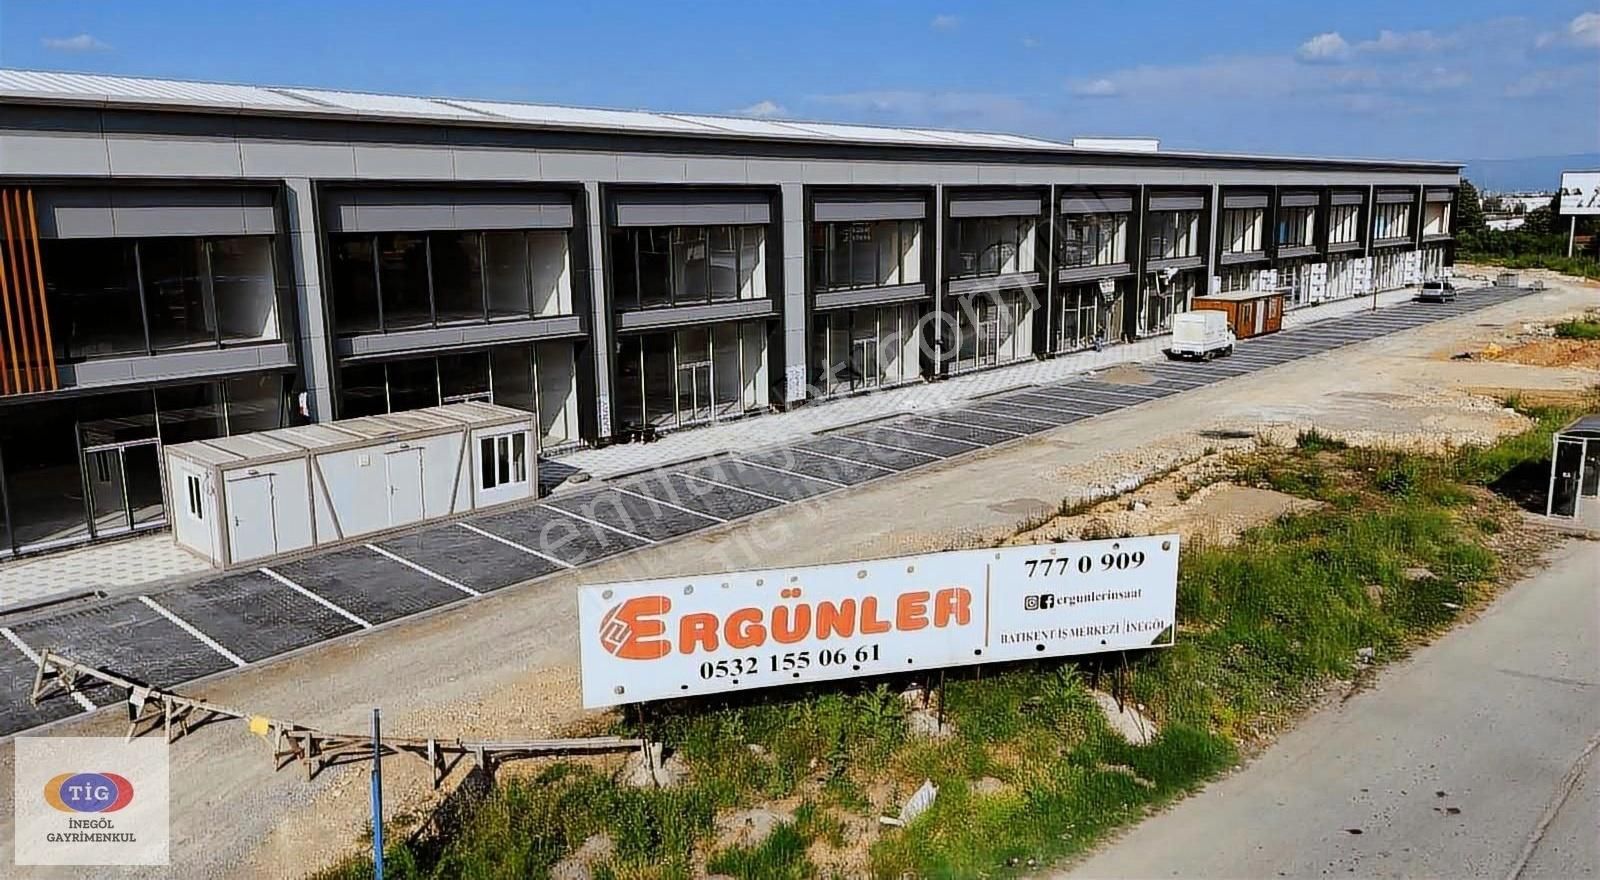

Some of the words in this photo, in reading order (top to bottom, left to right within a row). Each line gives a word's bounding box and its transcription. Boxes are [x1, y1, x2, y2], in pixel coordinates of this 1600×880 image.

[1024, 557, 1069, 578] 777
[1078, 555, 1092, 573] 0
[1101, 551, 1145, 571] 909
[599, 588, 972, 660] ERGÜNLER
[699, 658, 759, 681] 0532
[768, 654, 810, 675] 155
[819, 650, 848, 670] 06
[854, 645, 881, 664] 61
